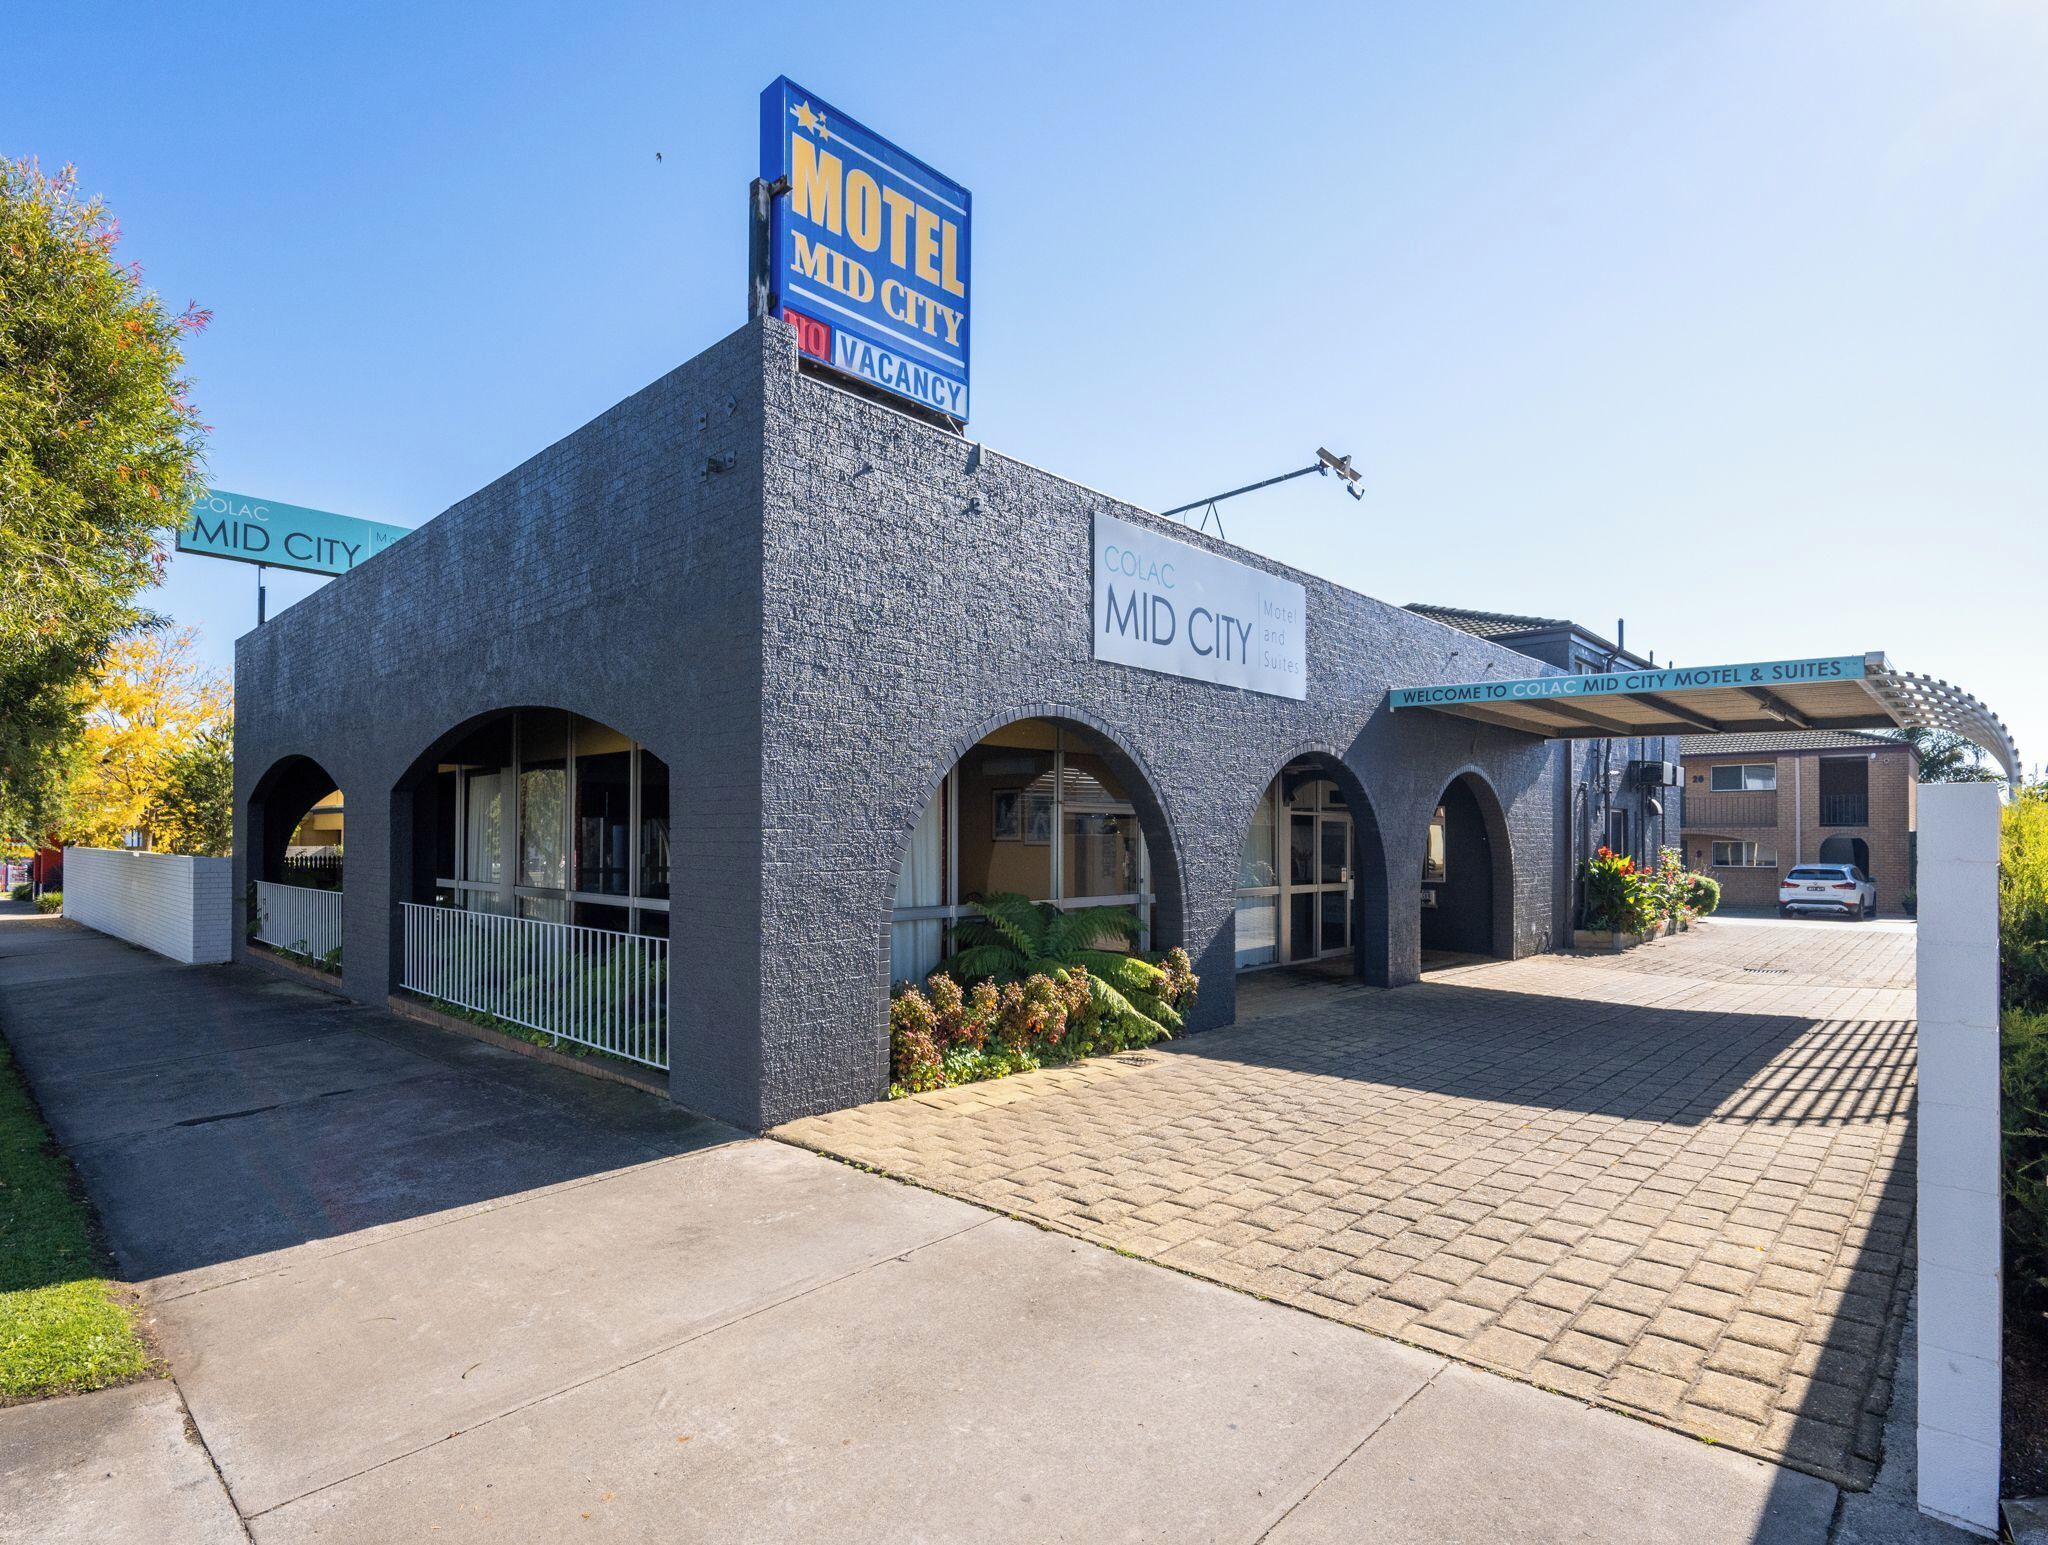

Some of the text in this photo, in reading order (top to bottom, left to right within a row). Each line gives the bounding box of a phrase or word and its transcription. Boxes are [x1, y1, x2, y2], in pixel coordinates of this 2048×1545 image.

[791, 131, 965, 299] MOTEL
[790, 229, 965, 347] MID CITY
[840, 334, 962, 410] VACANCY
[192, 515, 362, 568] MID CITY
[1104, 545, 1176, 589] COLAC
[1105, 582, 1252, 665] MID CITY
[1264, 599, 1297, 624] Motel
[1264, 629, 1285, 646] and
[1264, 650, 1300, 674] Suites
[1403, 661, 1841, 703] WELCOME TO COLAC MID CITY MOTEL & SUITES
